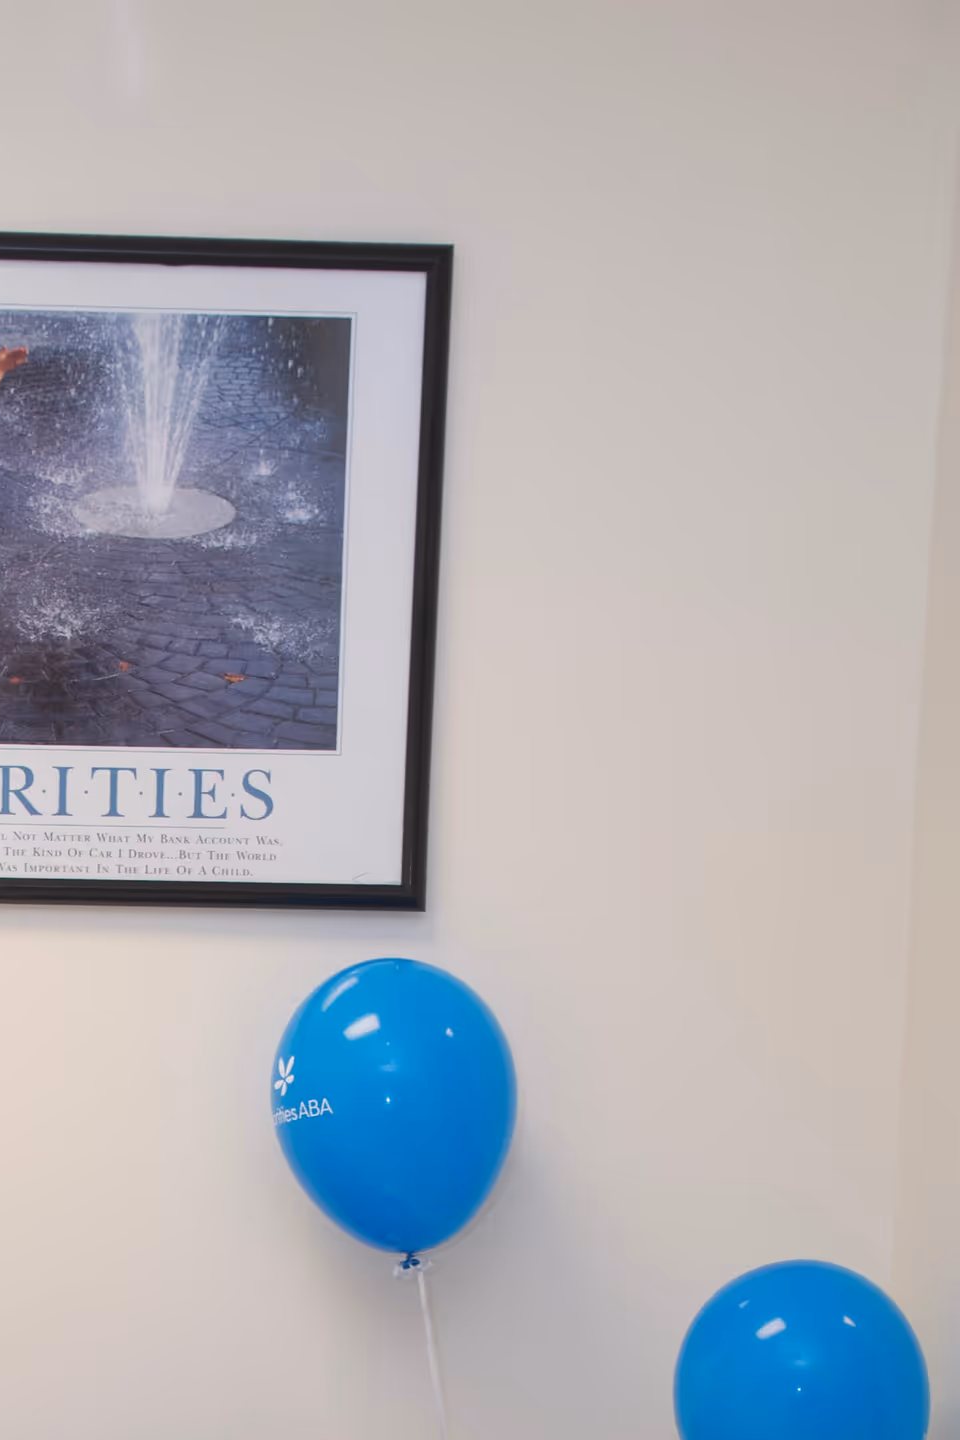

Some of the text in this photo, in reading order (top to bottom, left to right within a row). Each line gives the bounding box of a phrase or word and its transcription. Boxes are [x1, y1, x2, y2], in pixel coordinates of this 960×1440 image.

[43, 832, 92, 843] MATTER
[97, 833, 130, 844] WHAT
[136, 833, 154, 844] MY
[160, 834, 190, 845] BANK
[196, 835, 250, 845] ACCOUNT
[32, 847, 62, 857] KIND
[89, 848, 113, 858] CAR
[207, 850, 230, 861] THE
[235, 851, 276, 861] WORLD
[24, 862, 90, 873] IMPORTANT
[97, 863, 110, 873] IN
